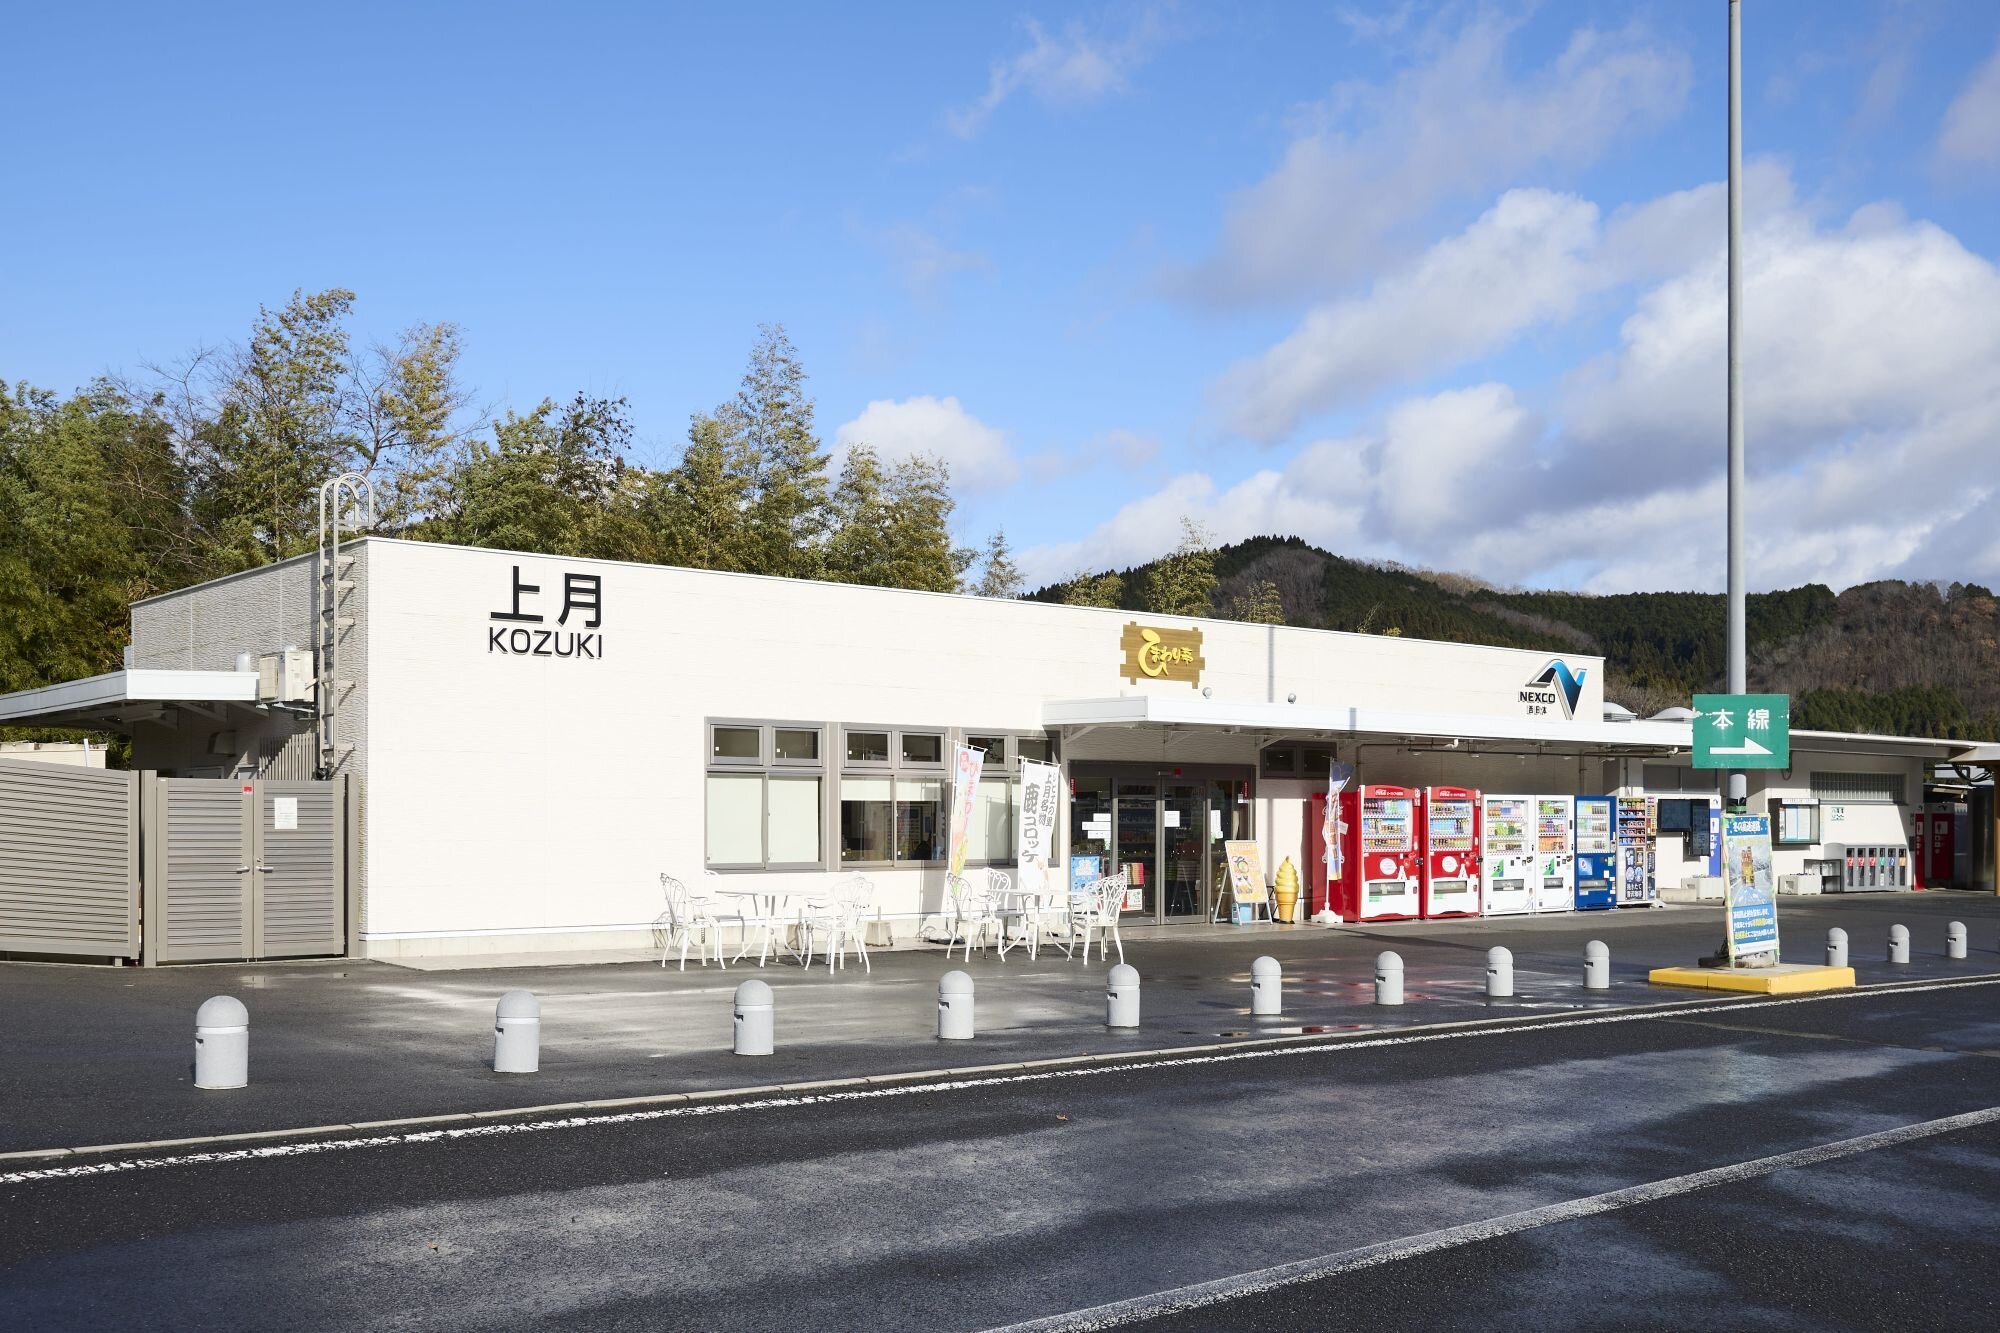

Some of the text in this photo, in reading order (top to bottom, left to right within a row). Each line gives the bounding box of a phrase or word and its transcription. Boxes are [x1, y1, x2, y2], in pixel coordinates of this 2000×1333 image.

[490, 565, 601, 628] 上月
[489, 626, 602, 659] KOZUKI
[1519, 691, 1556, 704] NEXCO
[1711, 708, 1770, 730] 本線
[1021, 782, 1041, 864] 鹿コロッケ
